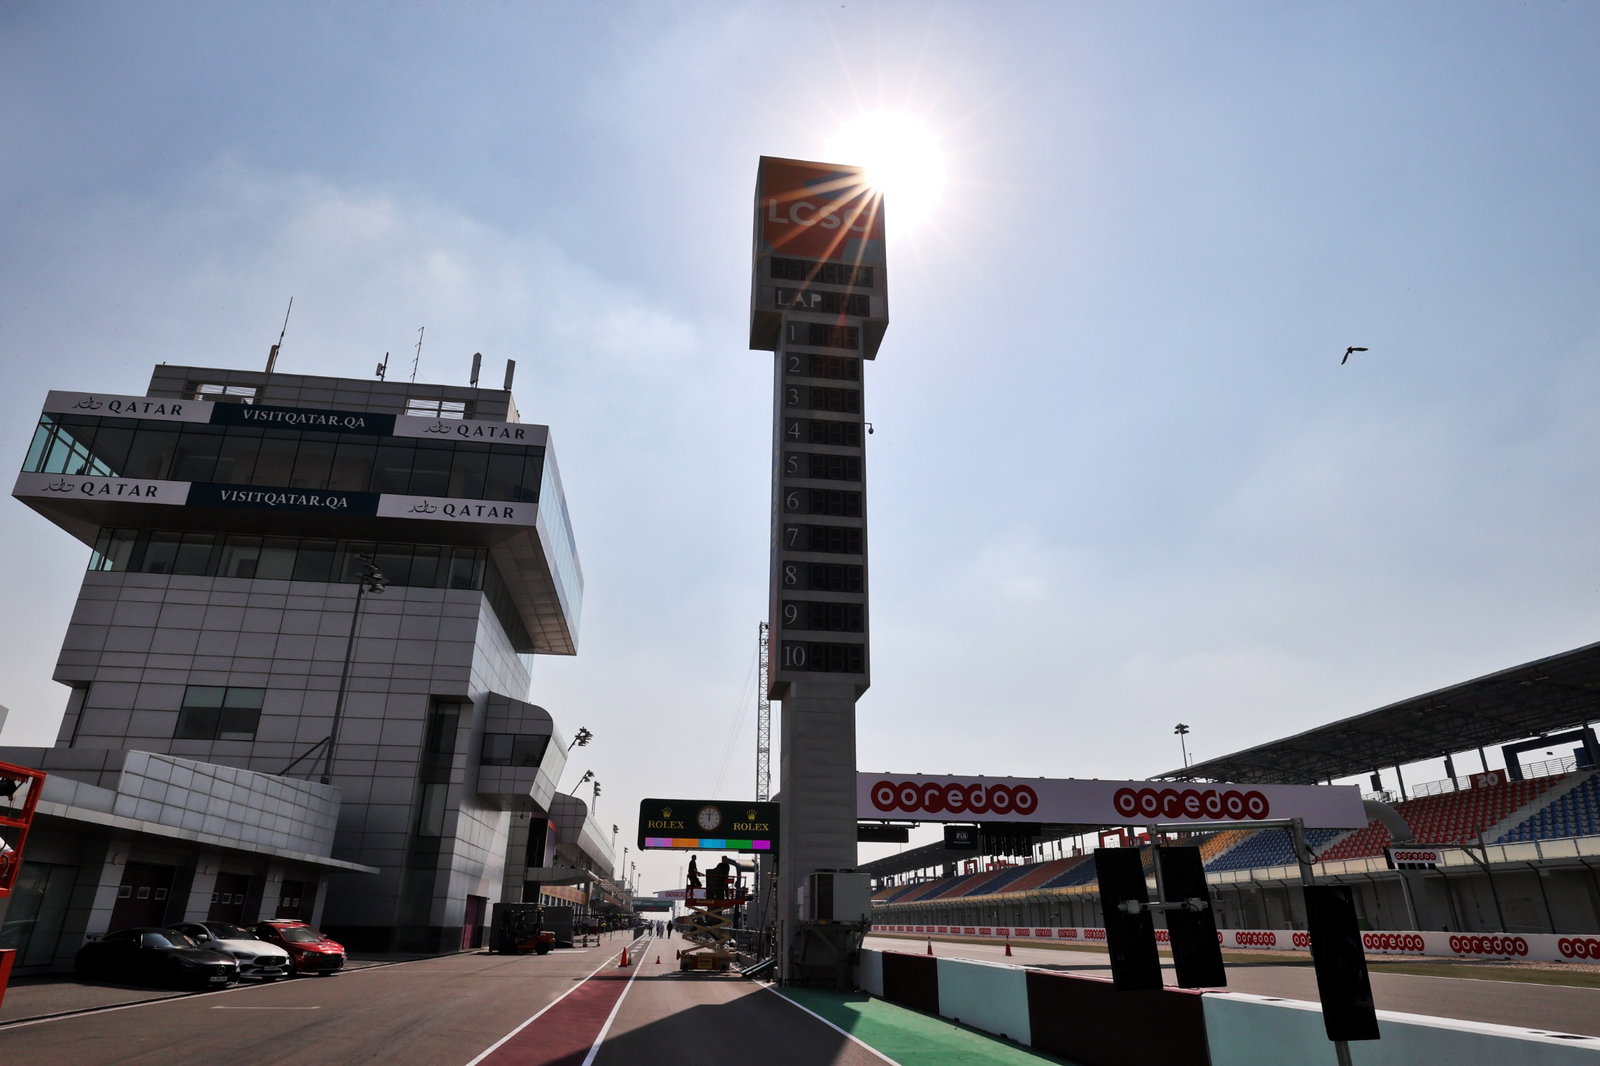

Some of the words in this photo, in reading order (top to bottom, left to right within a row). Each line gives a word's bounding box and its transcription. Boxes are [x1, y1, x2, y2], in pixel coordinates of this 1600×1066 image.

[778, 290, 822, 308] LAP
[790, 325, 796, 341] 1
[788, 356, 800, 373] 2
[788, 388, 799, 405] 3
[108, 400, 183, 416] QATAR
[243, 409, 366, 429] VISITQATAR.QA
[457, 424, 526, 440] QATAR
[788, 421, 800, 439] 4
[787, 456, 798, 474] 5
[80, 481, 158, 498] QATAR
[221, 490, 348, 510] VISITQATAR.QA
[786, 491, 799, 510] 6
[443, 503, 514, 519] QATAR
[786, 528, 799, 547] 7
[785, 565, 797, 585] 8
[785, 604, 797, 625] 9
[784, 646, 806, 667] 10
[874, 782, 1035, 812] ooredoo
[1116, 788, 1267, 817] ooredoo
[648, 820, 685, 829] ROLEX
[733, 822, 769, 831] ROLEX
[1236, 932, 1276, 946] ooredoo
[1364, 934, 1424, 950] ooredoo
[1451, 936, 1527, 955] ooredoo
